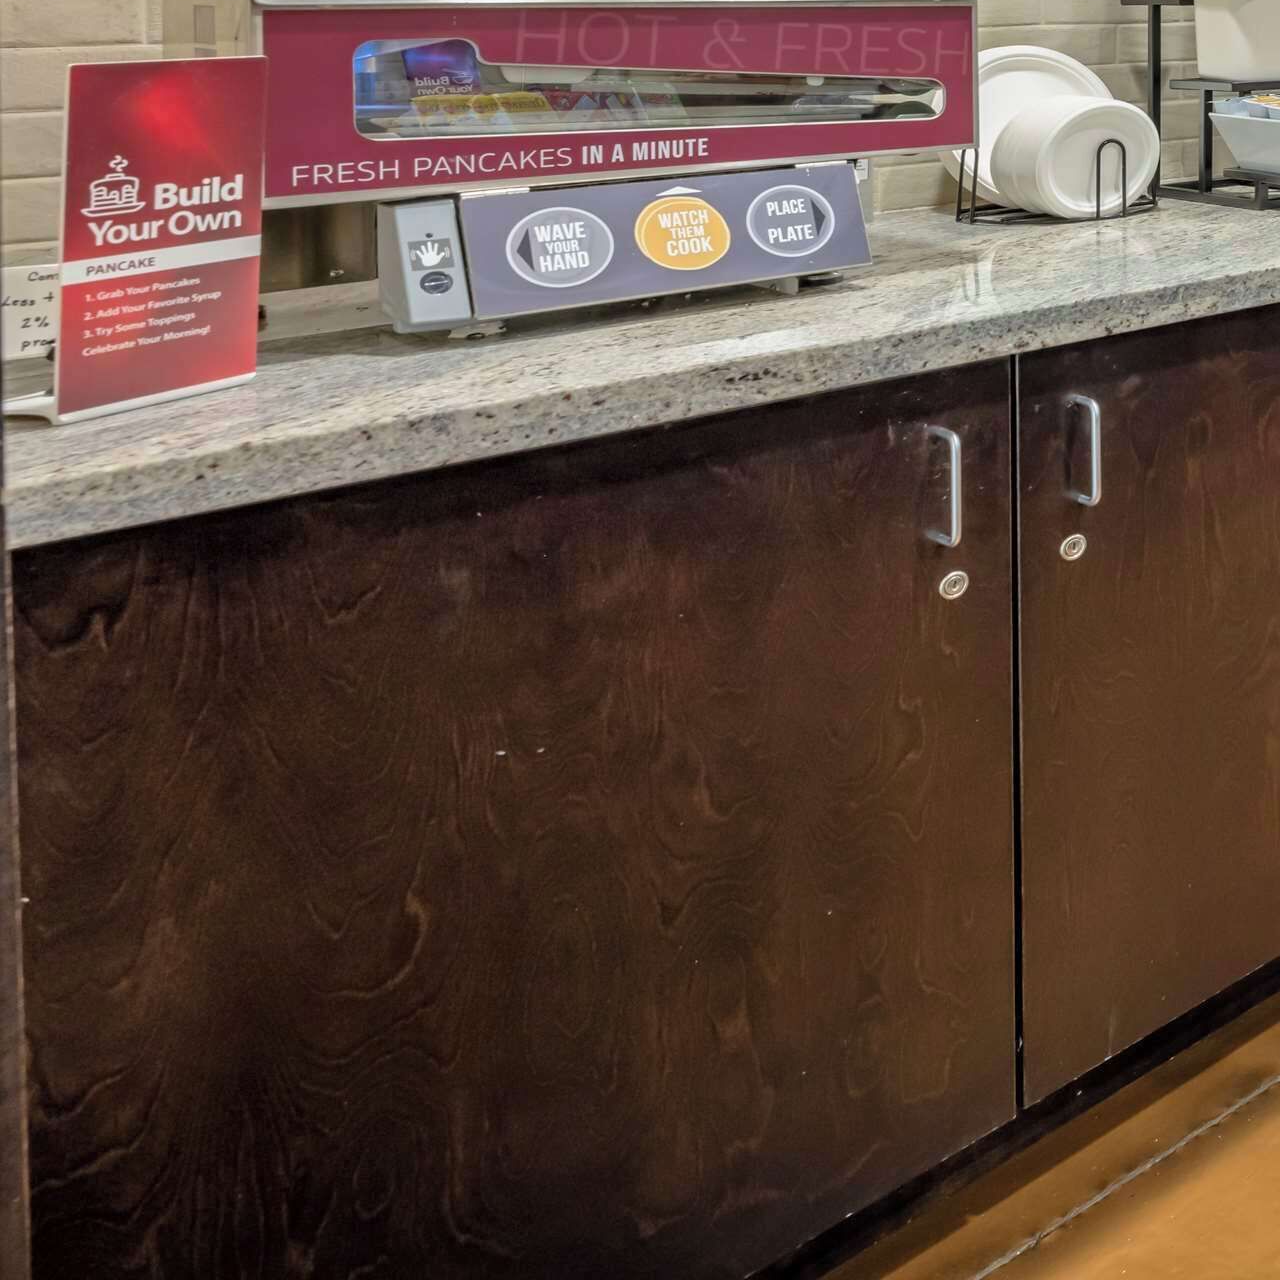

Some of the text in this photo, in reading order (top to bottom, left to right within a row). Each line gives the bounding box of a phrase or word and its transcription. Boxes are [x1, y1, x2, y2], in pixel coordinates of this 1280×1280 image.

[514, 8, 969, 76] HOT & FRESH
[291, 137, 710, 187] FRESH PANCAKES IN A MINUTE
[154, 174, 244, 210] Build
[657, 209, 710, 229] WATCH
[766, 198, 808, 217] PLACE
[87, 209, 242, 247] Your Own
[534, 221, 587, 244] WAVE
[669, 224, 705, 239] THEM
[767, 223, 815, 245] PLATE
[545, 240, 580, 254] YOUR
[666, 235, 714, 258] COOK
[85, 256, 157, 277] PANCAKE
[539, 250, 591, 273] HAND
[85, 276, 201, 303] 1. Grab Your Pancakes
[83, 290, 222, 321] 2. Add Your Favorite Syrup
[20, 316, 50, 329] 2%
[95, 326, 112, 337] Try
[114, 321, 146, 334] Some
[147, 311, 196, 327] Toppings
[81, 324, 212, 357] Celebrate Your Morning!
